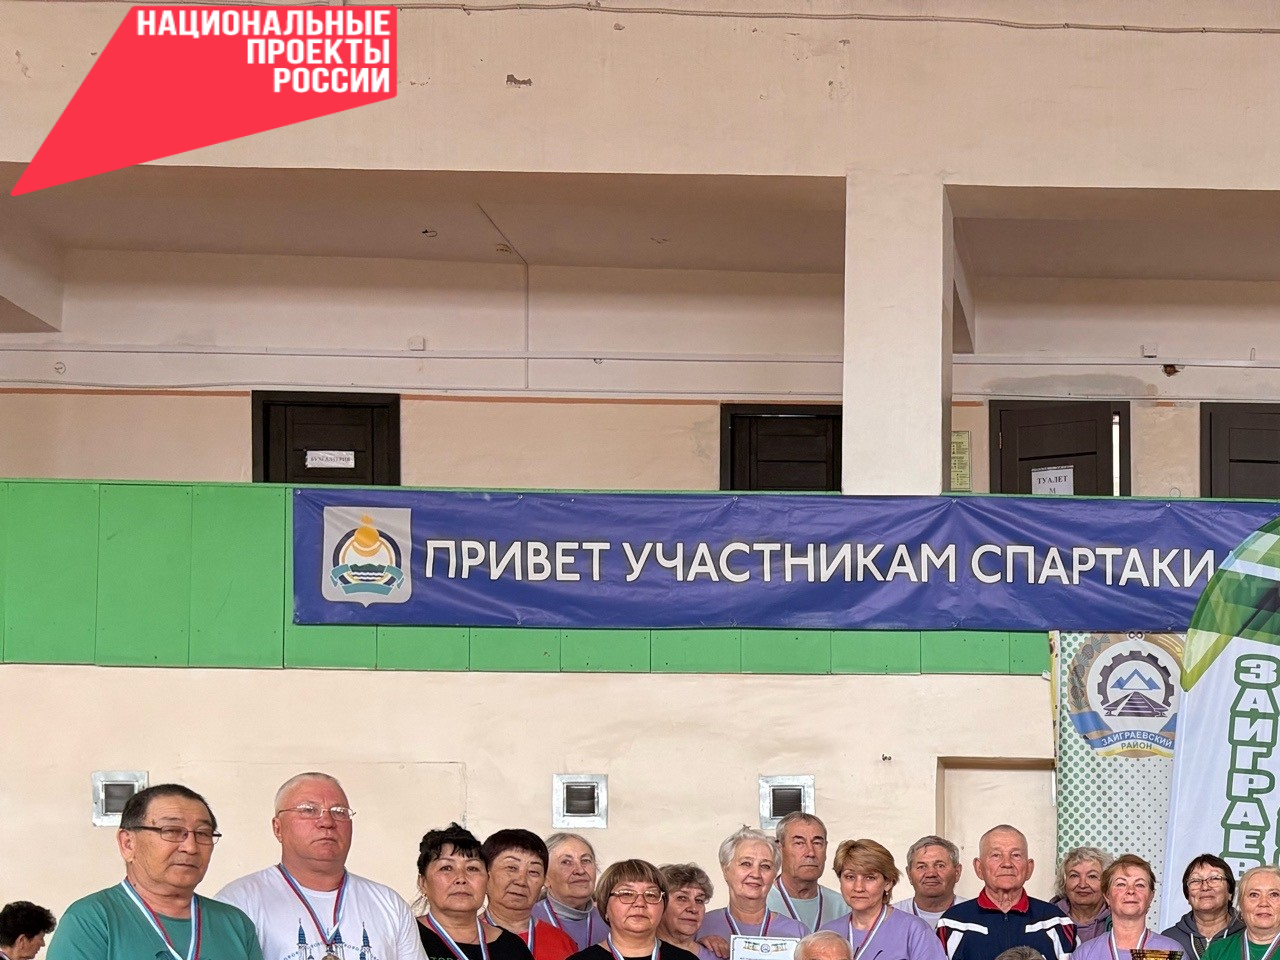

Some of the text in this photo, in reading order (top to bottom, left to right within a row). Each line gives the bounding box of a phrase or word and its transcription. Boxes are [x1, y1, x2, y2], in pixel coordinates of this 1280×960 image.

[1037, 475, 1068, 485] ТУАЛЕТ
[424, 539, 609, 581] ПРИВЕТ
[621, 541, 958, 583] УЧАСТНИКАМ
[1101, 731, 1173, 747] ЗАИГРАЕВСКИЙ
[1121, 740, 1153, 750] РАЙОН
